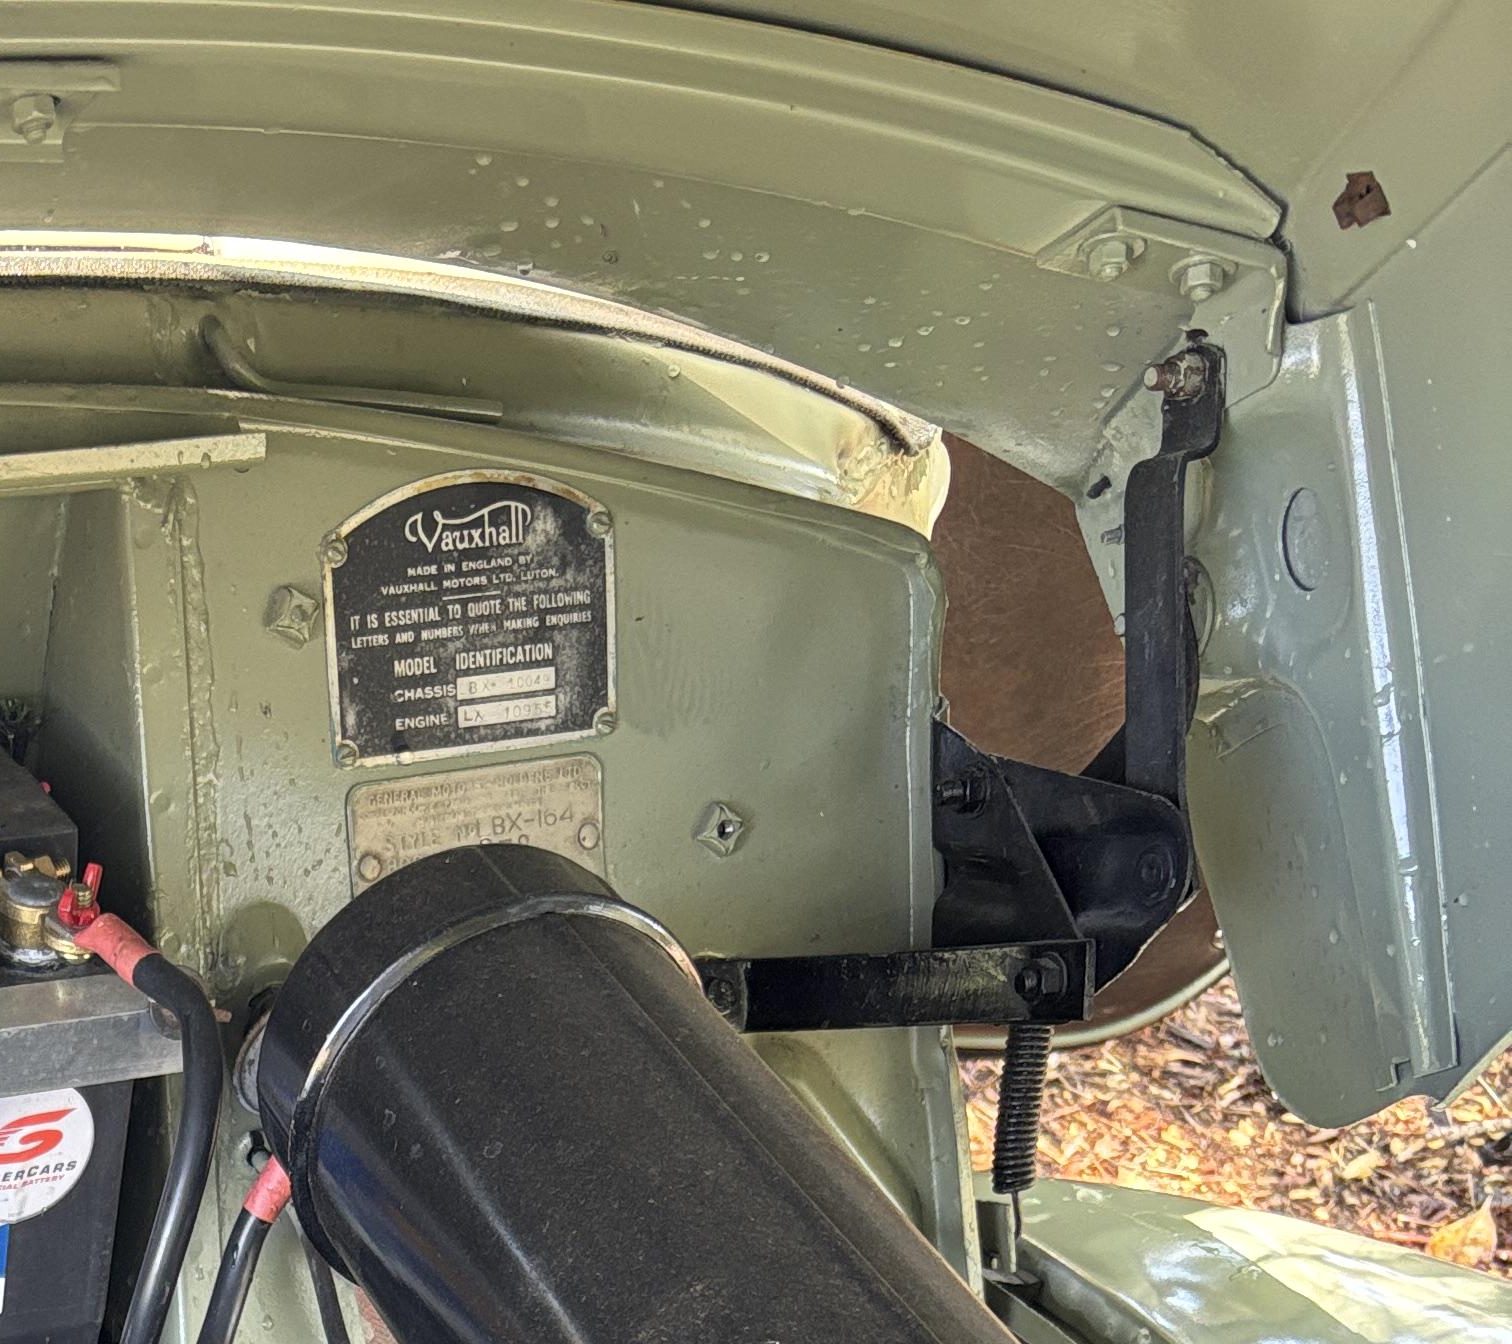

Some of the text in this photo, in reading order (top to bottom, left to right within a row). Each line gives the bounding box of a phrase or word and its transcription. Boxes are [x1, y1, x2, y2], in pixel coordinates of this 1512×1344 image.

[405, 500, 532, 553] Vauxhall
[407, 554, 532, 578] MADE IN ENGLAND BY
[380, 579, 438, 597] VAUXHALL
[442, 575, 488, 591] MOTORS
[350, 590, 592, 632] IT IS ESSENTIAL TO QUOTE THE FOLLOWING
[351, 610, 592, 650] LETTERS AND NUMBERS WHEN MAKING ENQUIRIES
[393, 643, 553, 678] MODEL IDENTIFICATION
[394, 684, 456, 703] CHASSIS
[395, 713, 450, 731] ENGINE
[21, 1173, 66, 1188] BATTERY
